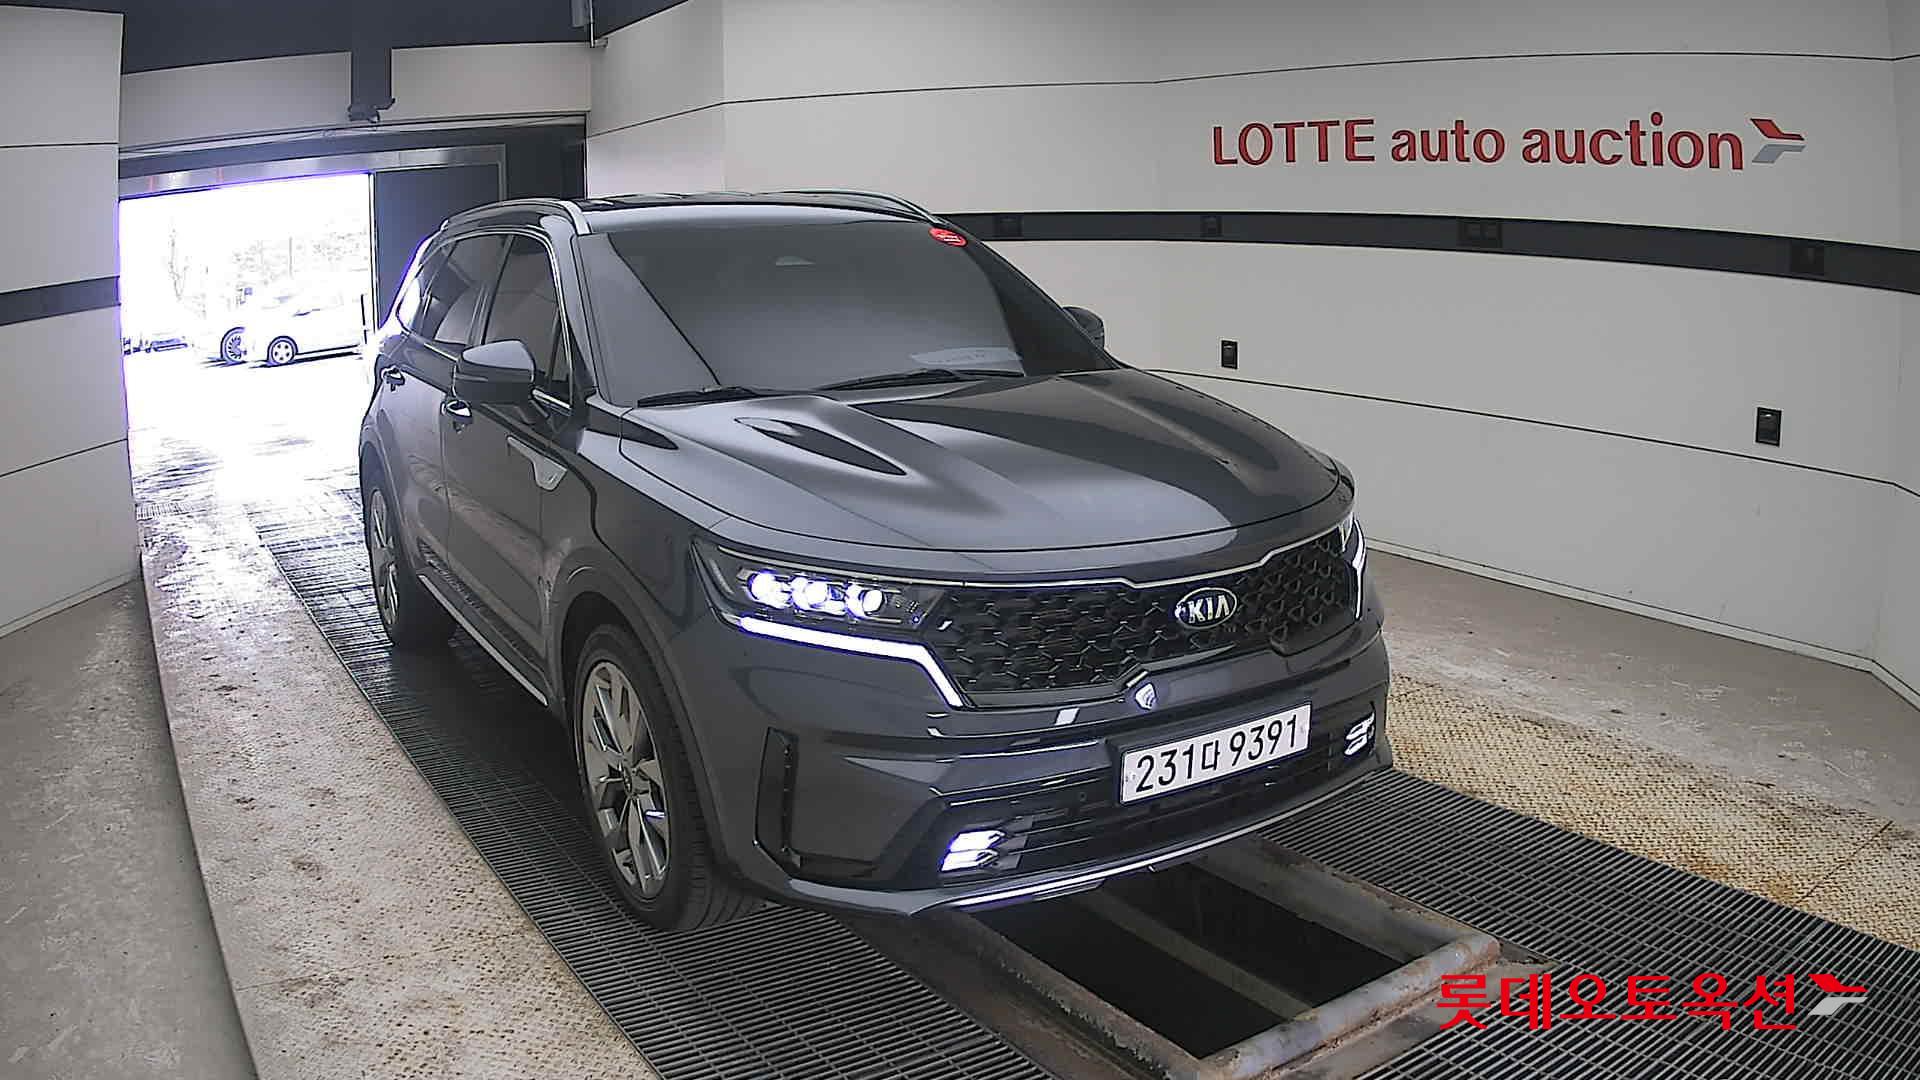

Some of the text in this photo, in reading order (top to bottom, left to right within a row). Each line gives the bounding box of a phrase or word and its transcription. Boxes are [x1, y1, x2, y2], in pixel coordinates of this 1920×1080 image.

[1213, 111, 1744, 170] LOTTE auto auction
[1188, 594, 1231, 623] KIA
[1135, 714, 1298, 793] 231다 9391
